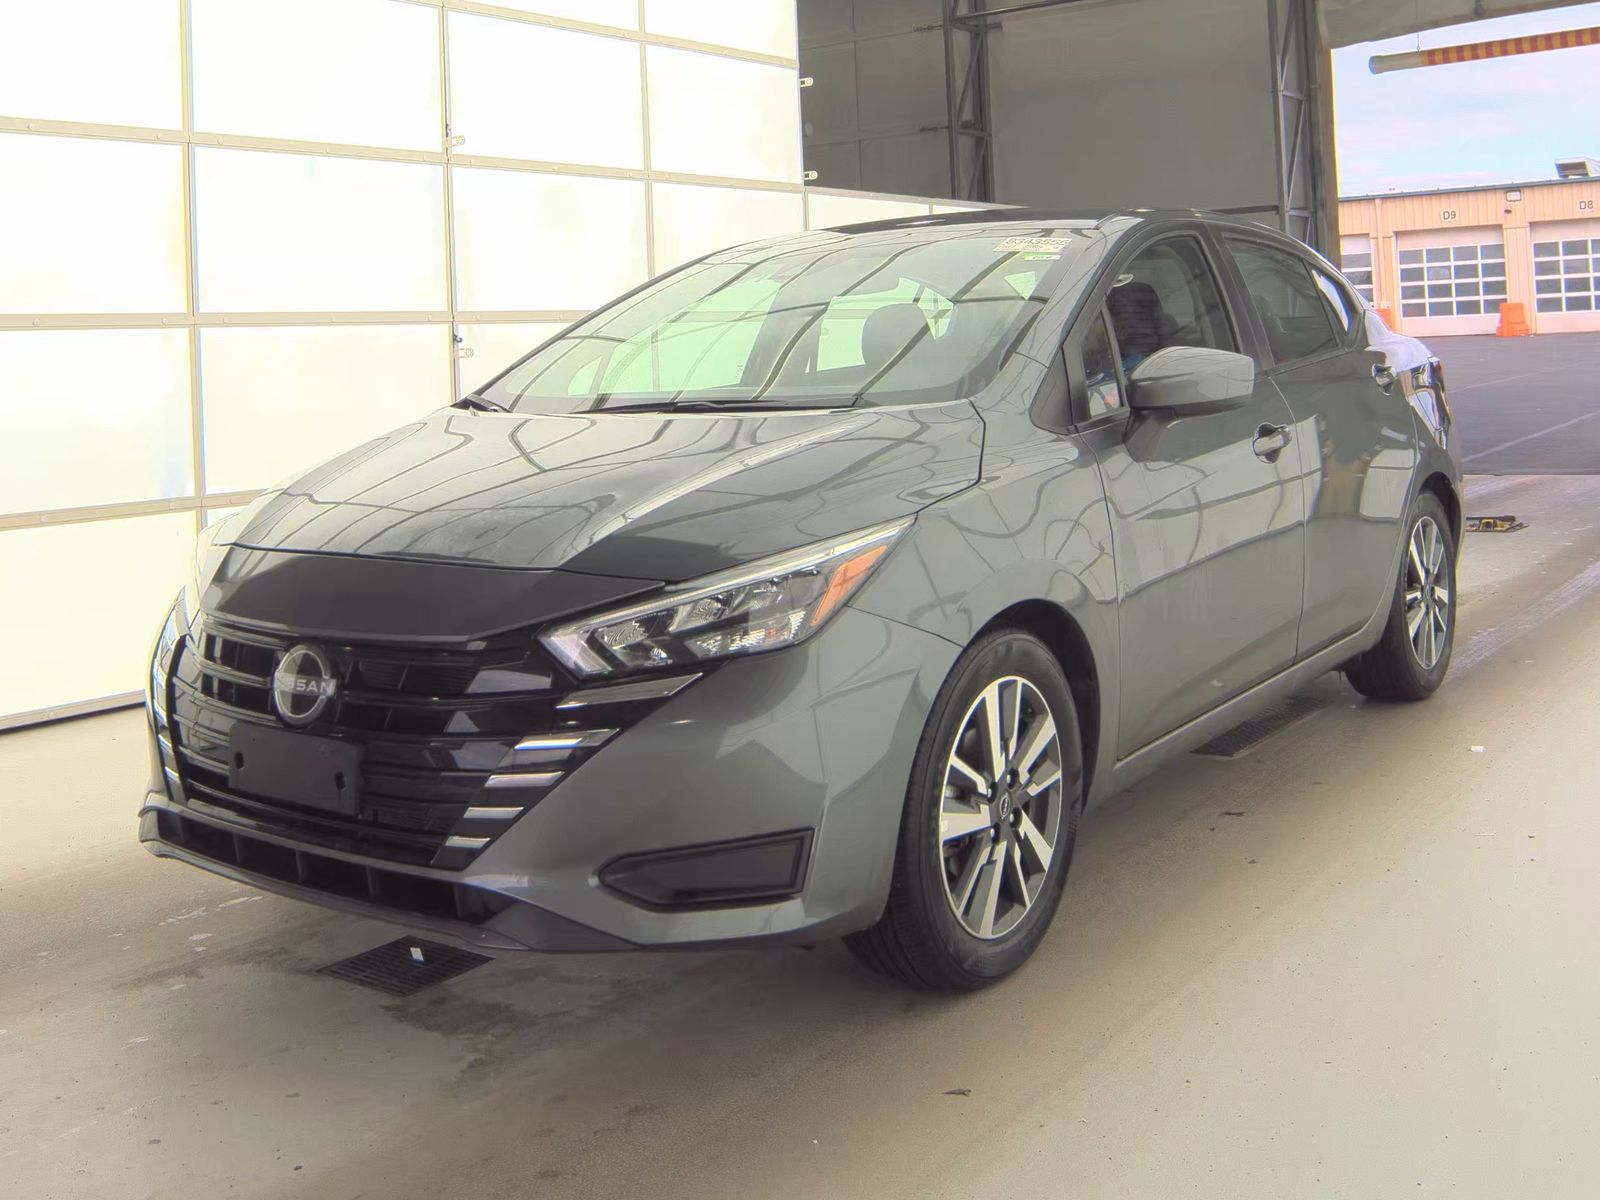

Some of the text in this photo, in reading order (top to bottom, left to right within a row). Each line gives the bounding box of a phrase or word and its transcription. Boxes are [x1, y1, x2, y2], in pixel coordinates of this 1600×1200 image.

[1579, 201, 1593, 210] D8
[1443, 211, 1457, 220] D9
[277, 673, 334, 693] SSAN
